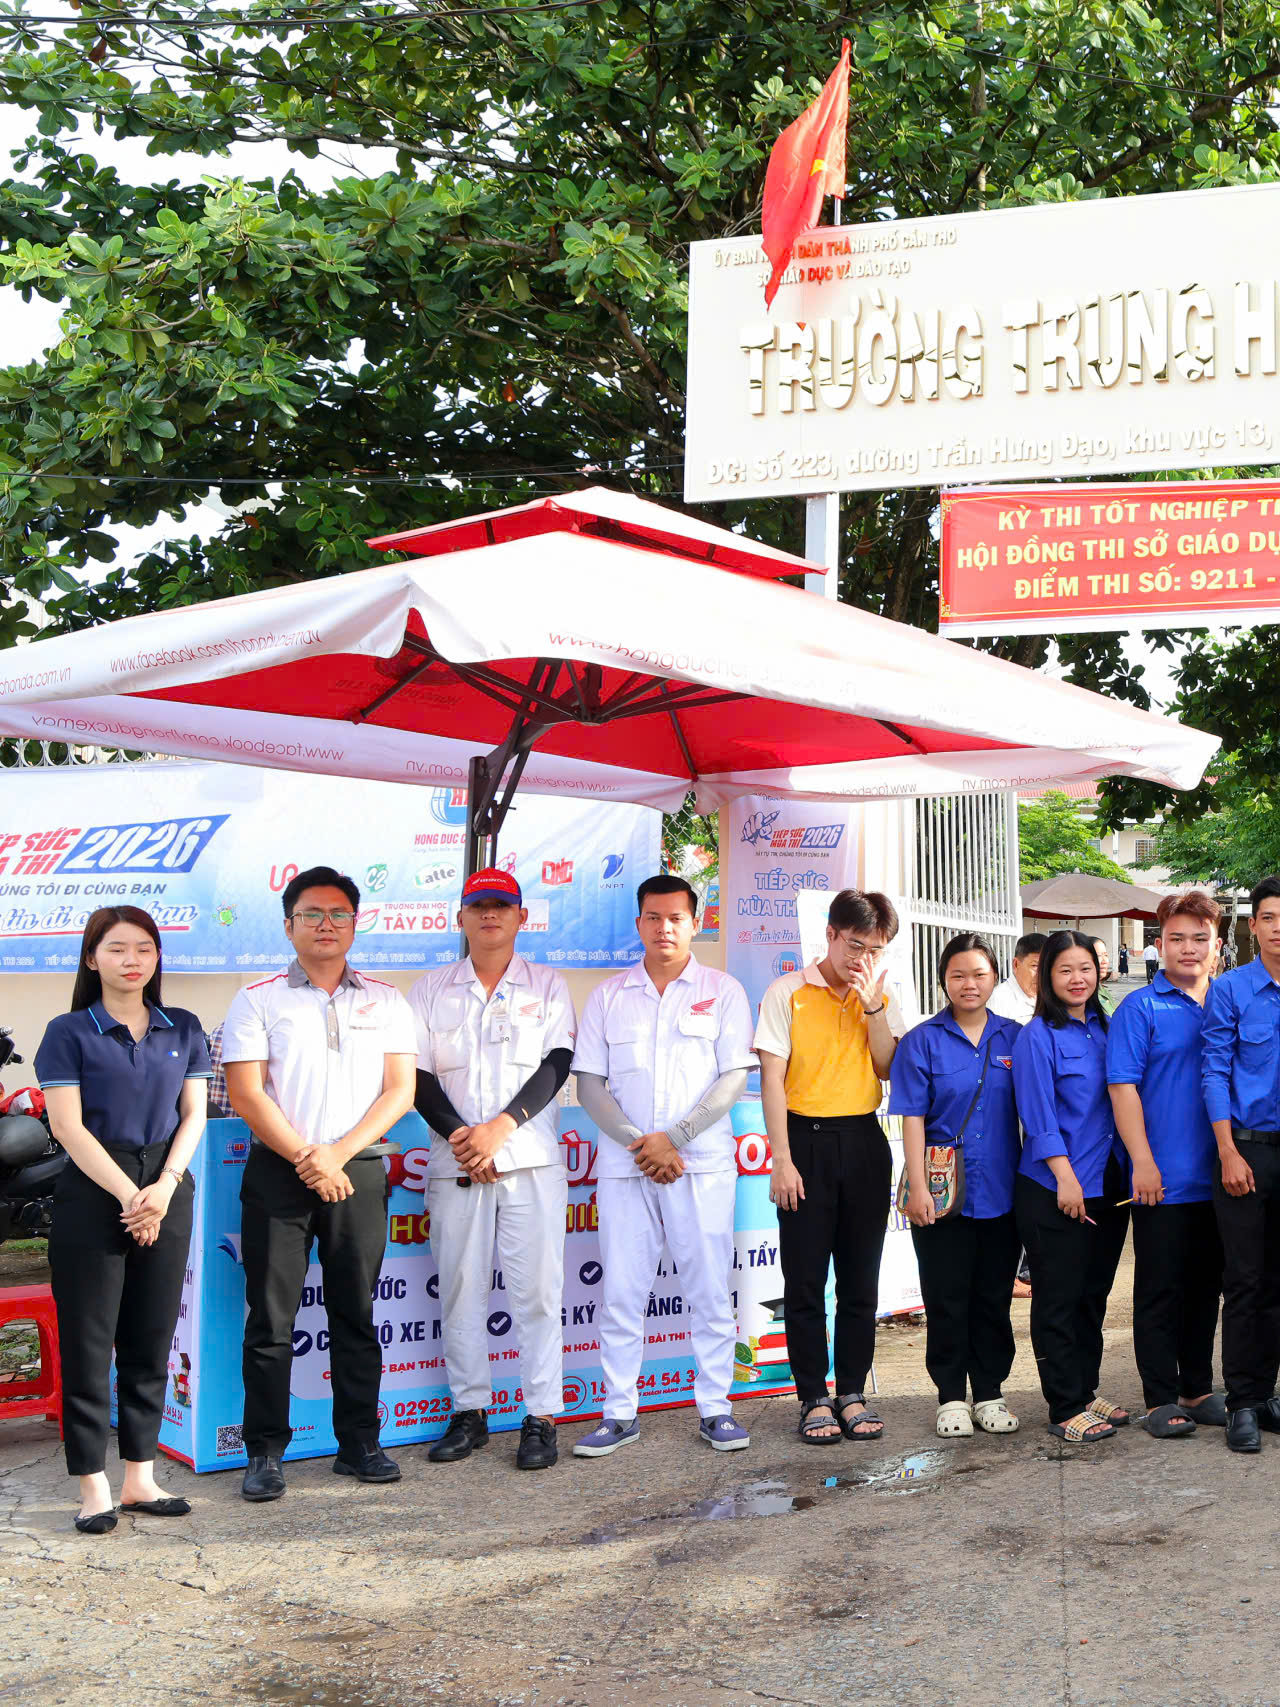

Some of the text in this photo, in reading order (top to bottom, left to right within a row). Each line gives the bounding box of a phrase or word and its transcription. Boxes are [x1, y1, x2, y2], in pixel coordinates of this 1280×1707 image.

[734, 249, 758, 266] BAN
[799, 242, 823, 259] DÂN
[826, 237, 870, 257] THÀNH
[872, 230, 899, 250] PHỐ
[902, 229, 927, 249] CẦN
[808, 263, 833, 285] DỤC
[837, 261, 853, 280] VÀ
[855, 259, 881, 278] ĐÀO
[887, 258, 911, 280] TẠO
[740, 287, 984, 415] TRƯỜNG
[1002, 283, 1216, 393] TRUNG
[753, 447, 784, 480] Số
[790, 450, 839, 481] 223,
[847, 445, 919, 475] đường
[929, 435, 982, 468] Trần
[990, 432, 1052, 465] Hưng
[1062, 430, 1117, 464] Đạo,
[1126, 422, 1170, 454] khu
[1182, 423, 1226, 456] vực
[1234, 417, 1273, 450] 13,
[998, 504, 1030, 532] KỲ
[1040, 505, 1081, 528] THI
[1090, 499, 1141, 525] TỐT
[1150, 497, 1248, 522] NGHIỆP
[958, 541, 998, 571] HỘI
[1006, 534, 1075, 565] ĐỒNG
[1082, 537, 1125, 561] THI
[1133, 529, 1170, 558] SỞ
[1177, 527, 1240, 556] GIÁO
[1014, 566, 1079, 600] ĐIỂM
[1087, 574, 1129, 595] THI
[1138, 563, 1181, 592] SỐ:
[1190, 567, 1256, 591] 9211
[21, 827, 82, 853] SỨC
[63, 818, 213, 869] 2026
[802, 826, 841, 847] 2026
[11, 853, 63, 875] THI
[36, 882, 61, 895] TÔI
[64, 884, 80, 895] ĐI
[84, 881, 127, 895] CÙNG
[130, 883, 167, 896] BẠN
[755, 867, 829, 891] TIẾP SỨC
[738, 894, 798, 917] MÙA TH
[384, 913, 418, 930] TÂY
[422, 912, 447, 930] ĐÔ
[748, 1241, 777, 1267] TẨY
[573, 1301, 597, 1325] KÝ
[644, 1292, 683, 1318] ẰNG
[400, 1321, 425, 1343] XE
[649, 1331, 686, 1344] BÀI THI
[389, 1361, 416, 1374] BẠN
[418, 1358, 439, 1370] THÍ
[502, 1349, 520, 1360] TĨN
[636, 1374, 656, 1389] 54
[661, 1371, 681, 1386] 54
[394, 1397, 452, 1418] 02923
[396, 1417, 417, 1428] ĐIỆN
[420, 1414, 449, 1425] THOẠI
[499, 1405, 519, 1415] MÁY
